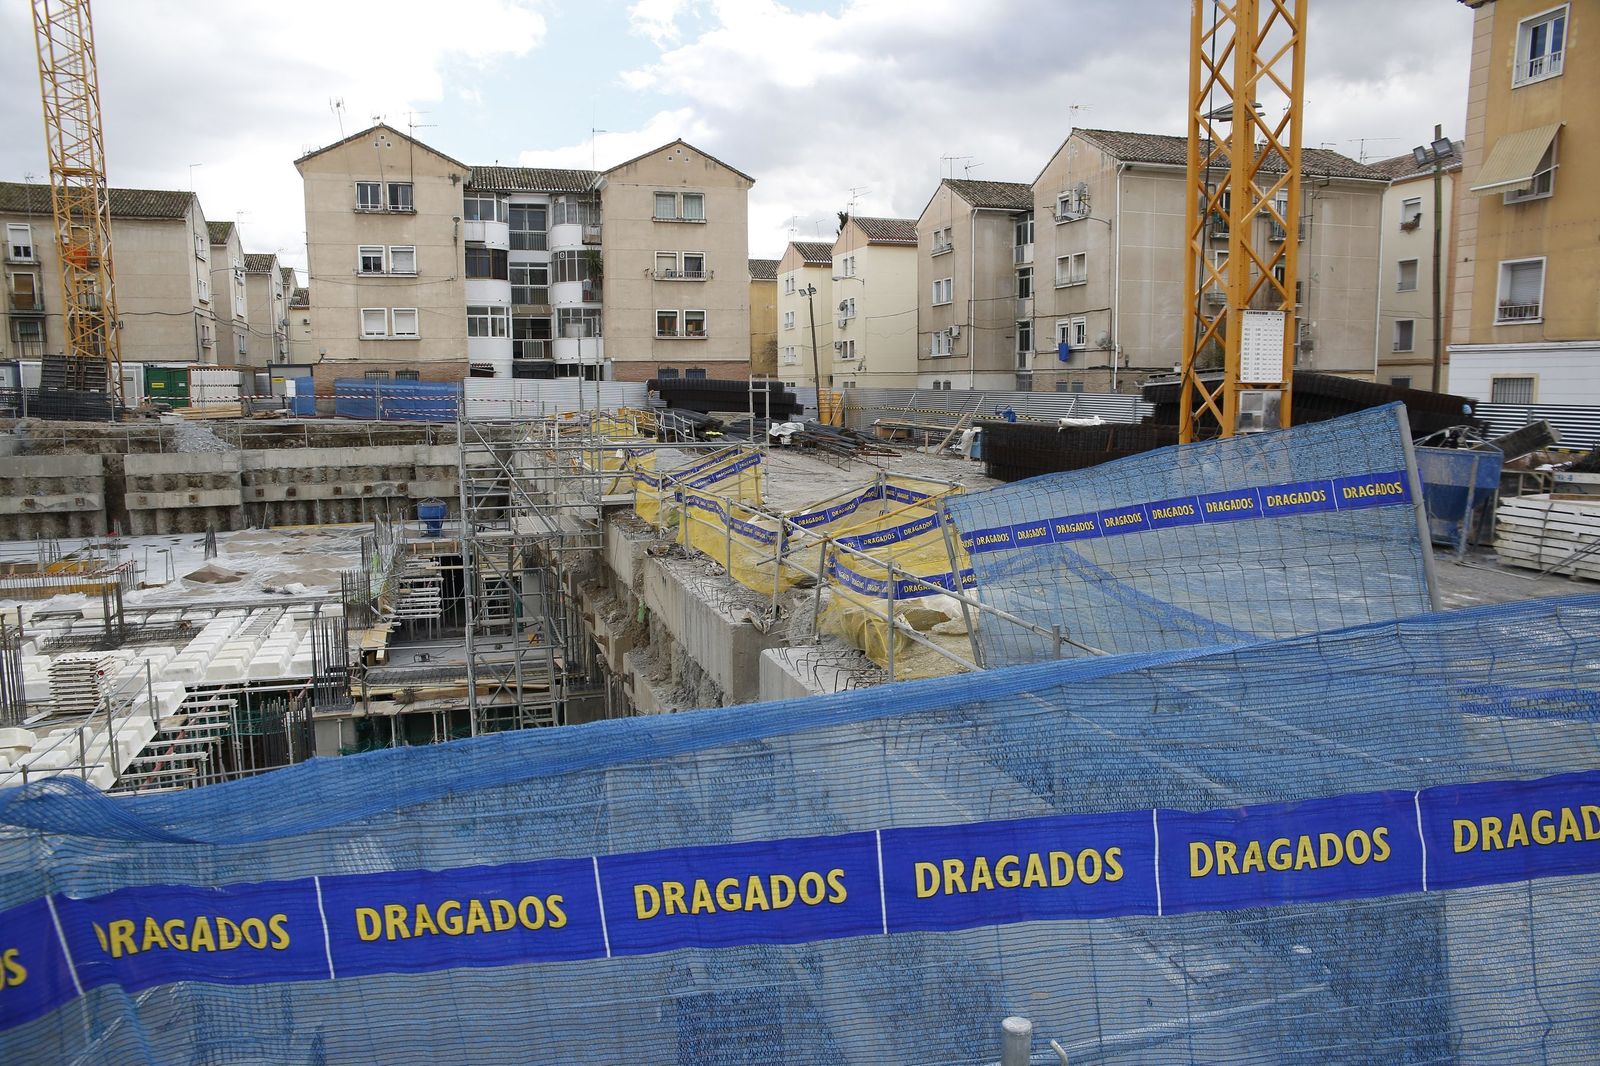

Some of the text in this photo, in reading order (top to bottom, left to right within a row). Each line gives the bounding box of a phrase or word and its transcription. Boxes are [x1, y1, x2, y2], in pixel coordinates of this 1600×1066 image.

[863, 533, 896, 546] DRAGADOS
[903, 520, 934, 536] DRAGADOS
[1056, 520, 1096, 534] DRAGADOS
[1104, 512, 1143, 528] DRAGADOS
[1151, 504, 1195, 520] DRAGADOS
[1205, 495, 1254, 513] DRAGADOS
[1266, 489, 1327, 508] DRAGADOS
[1343, 481, 1404, 500] DRAGADOS
[355, 893, 568, 943] DRAGADOS
[633, 868, 848, 921] DRAGADOS
[913, 846, 1124, 900] DRAGADOS
[1188, 825, 1391, 879] DRAGADOS
